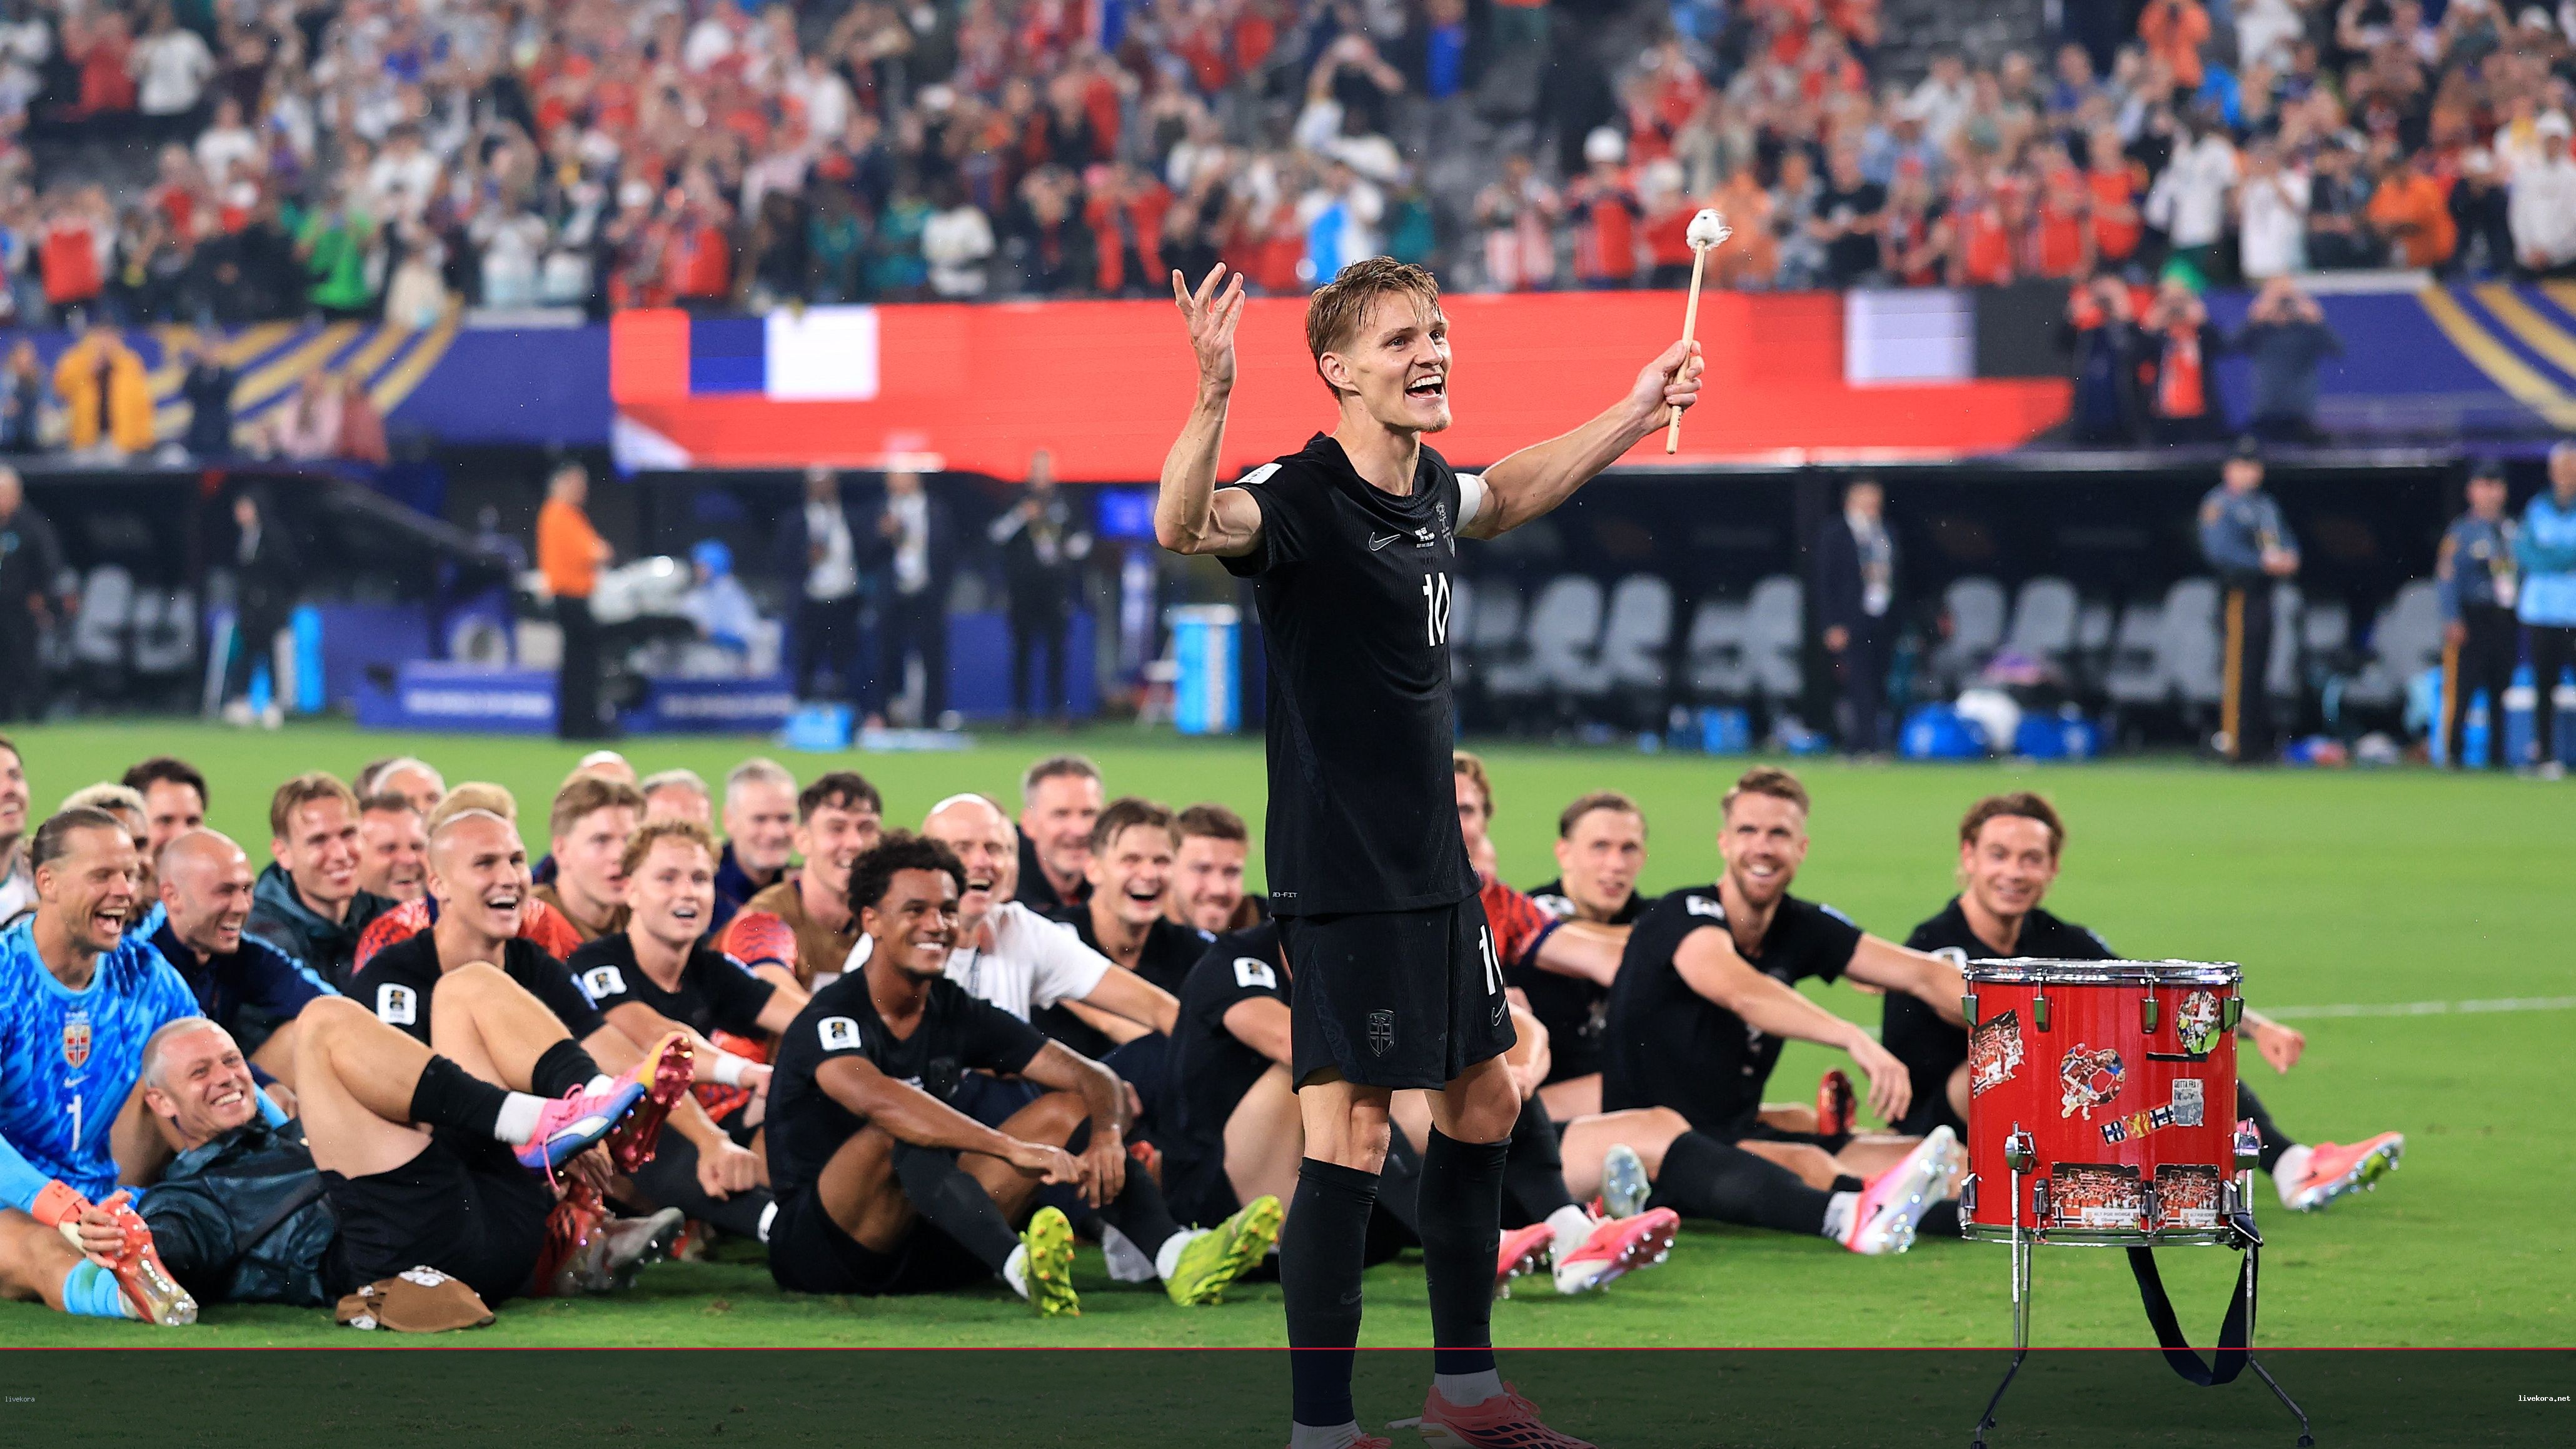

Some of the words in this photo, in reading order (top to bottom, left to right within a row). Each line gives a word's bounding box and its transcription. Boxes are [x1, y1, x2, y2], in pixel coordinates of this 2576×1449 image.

[1422, 572, 1451, 646] 10
[66, 1094, 82, 1152] 1
[2100, 1121, 2126, 1145] 18
